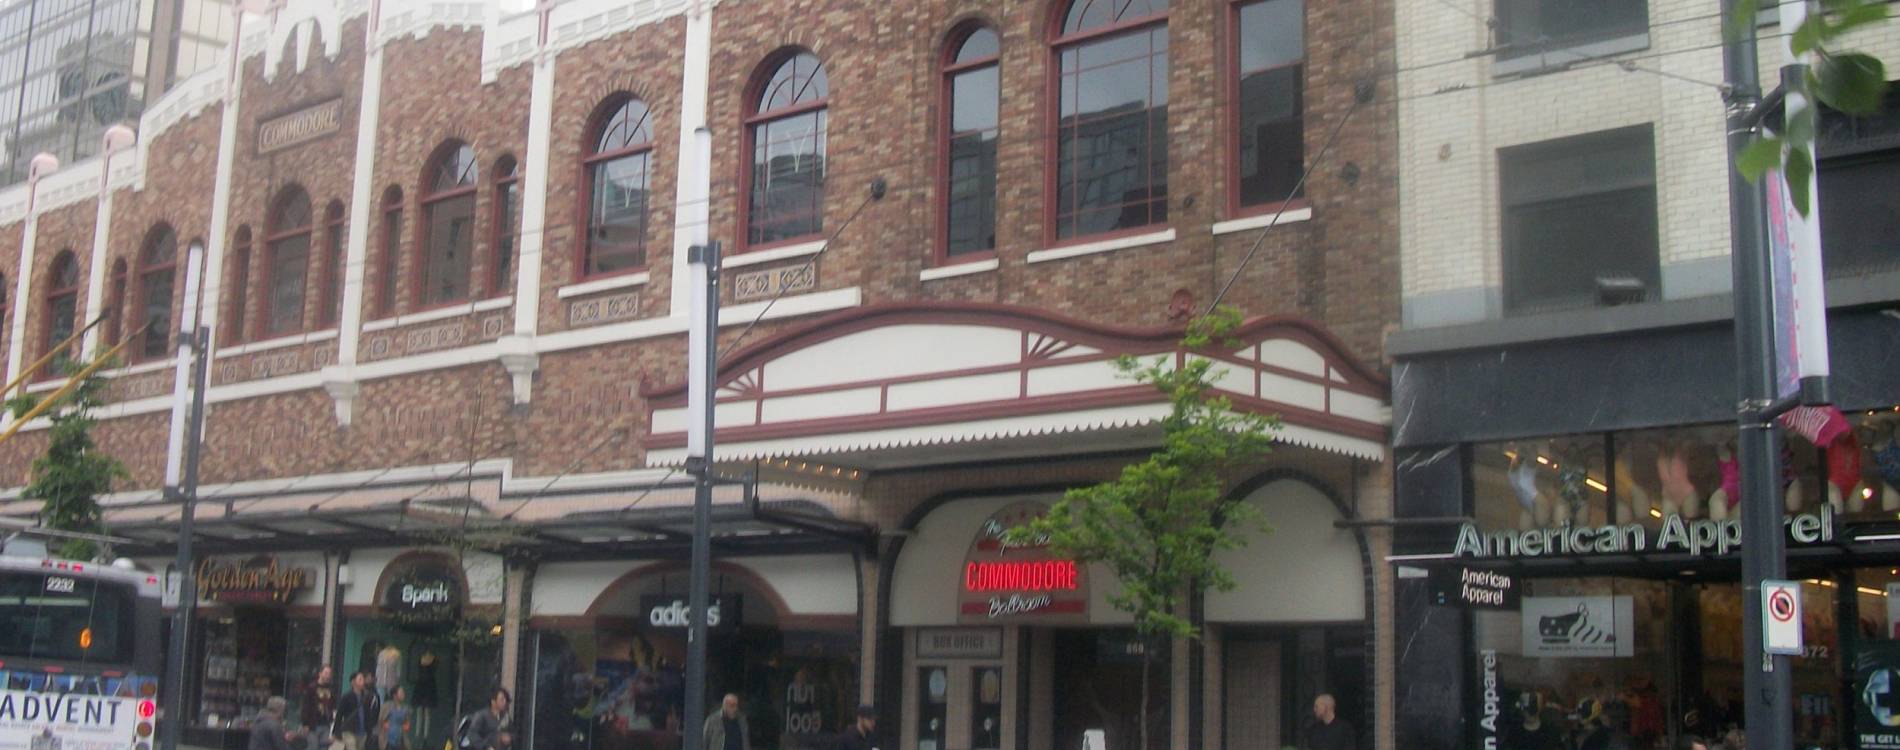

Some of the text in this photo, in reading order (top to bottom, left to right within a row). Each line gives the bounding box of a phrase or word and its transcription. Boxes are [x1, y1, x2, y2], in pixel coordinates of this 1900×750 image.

[263, 107, 337, 145] COMMODORE
[1453, 503, 1832, 557] American Appel
[47, 576, 75, 592] 2232
[197, 556, 304, 603] Golden Age
[966, 560, 1077, 591] COMMODORE
[1461, 567, 1511, 589] American
[988, 593, 1051, 618] Ballroom
[1461, 585, 1504, 605] Apparel
[953, 632, 985, 649] OFFICE
[1480, 649, 1500, 732] Apparel
[0, 694, 122, 725] ADVENT
[1860, 734, 1875, 744] THE
[1877, 734, 1893, 744] GET
